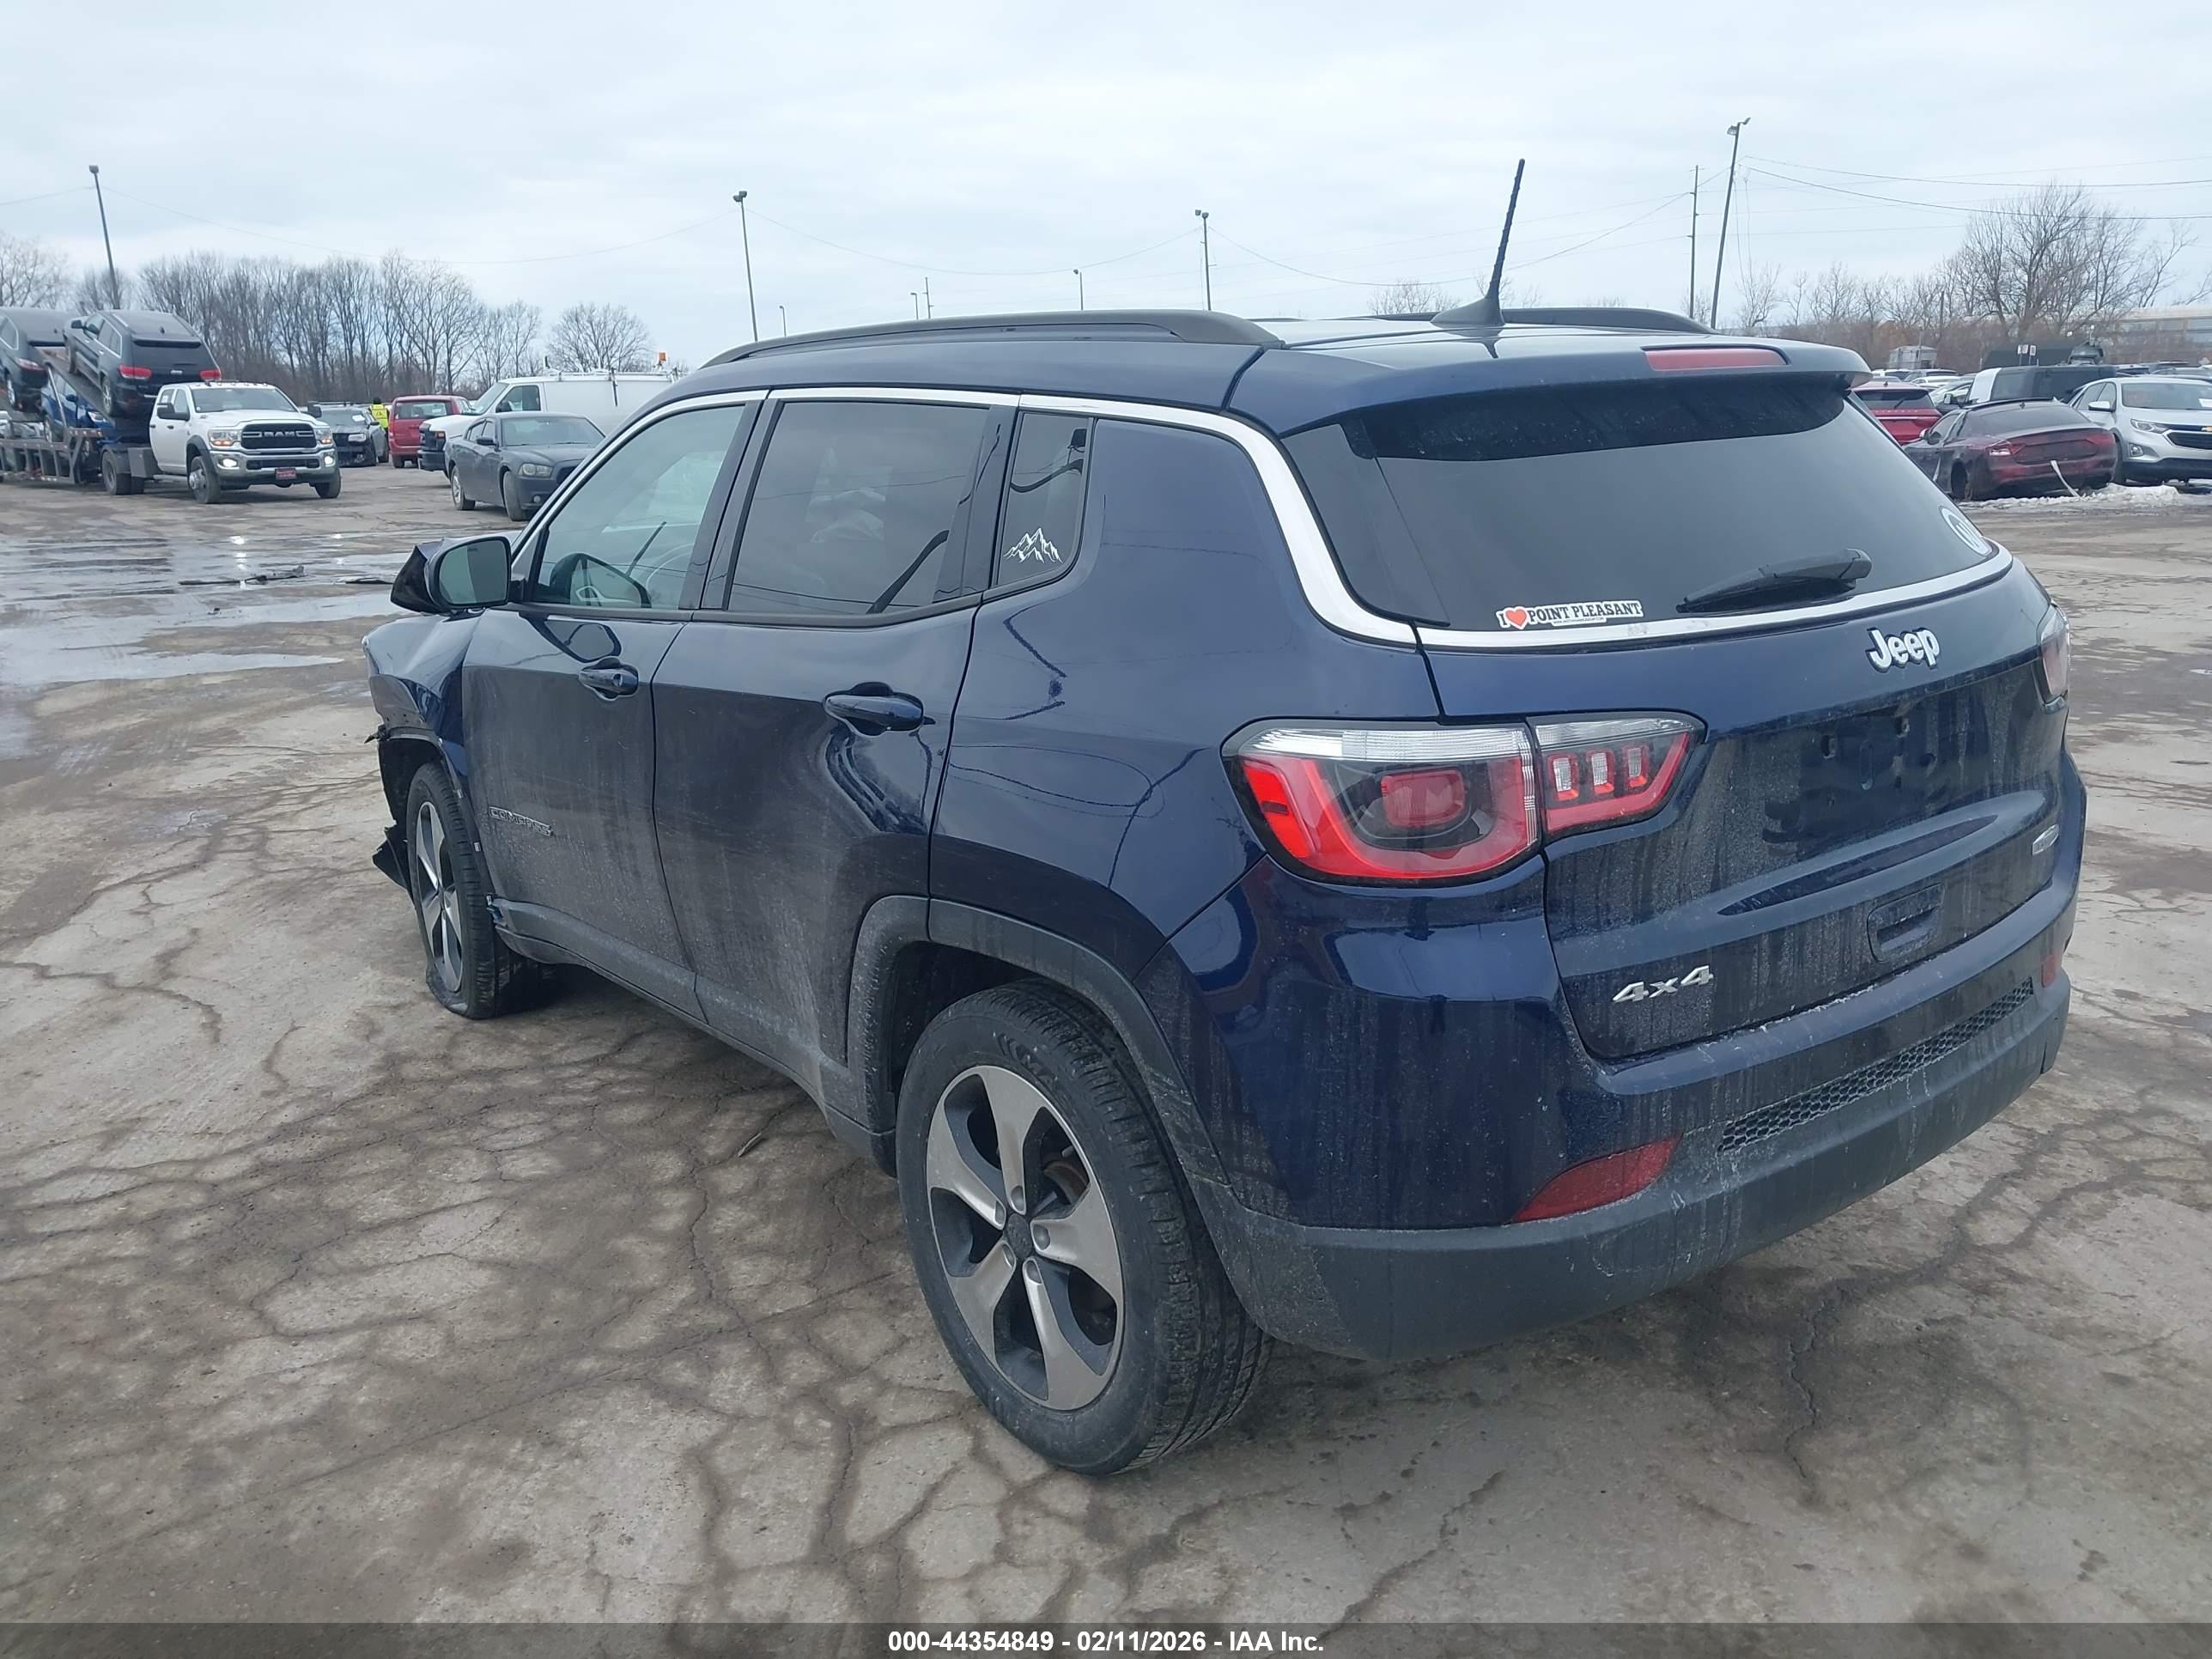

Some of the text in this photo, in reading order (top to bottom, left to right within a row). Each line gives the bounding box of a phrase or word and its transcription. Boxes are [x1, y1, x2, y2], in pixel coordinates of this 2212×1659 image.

[1528, 606, 1570, 623] POINT
[1571, 601, 1642, 618] PLEASANT
[1866, 628, 1941, 671] Jeep
